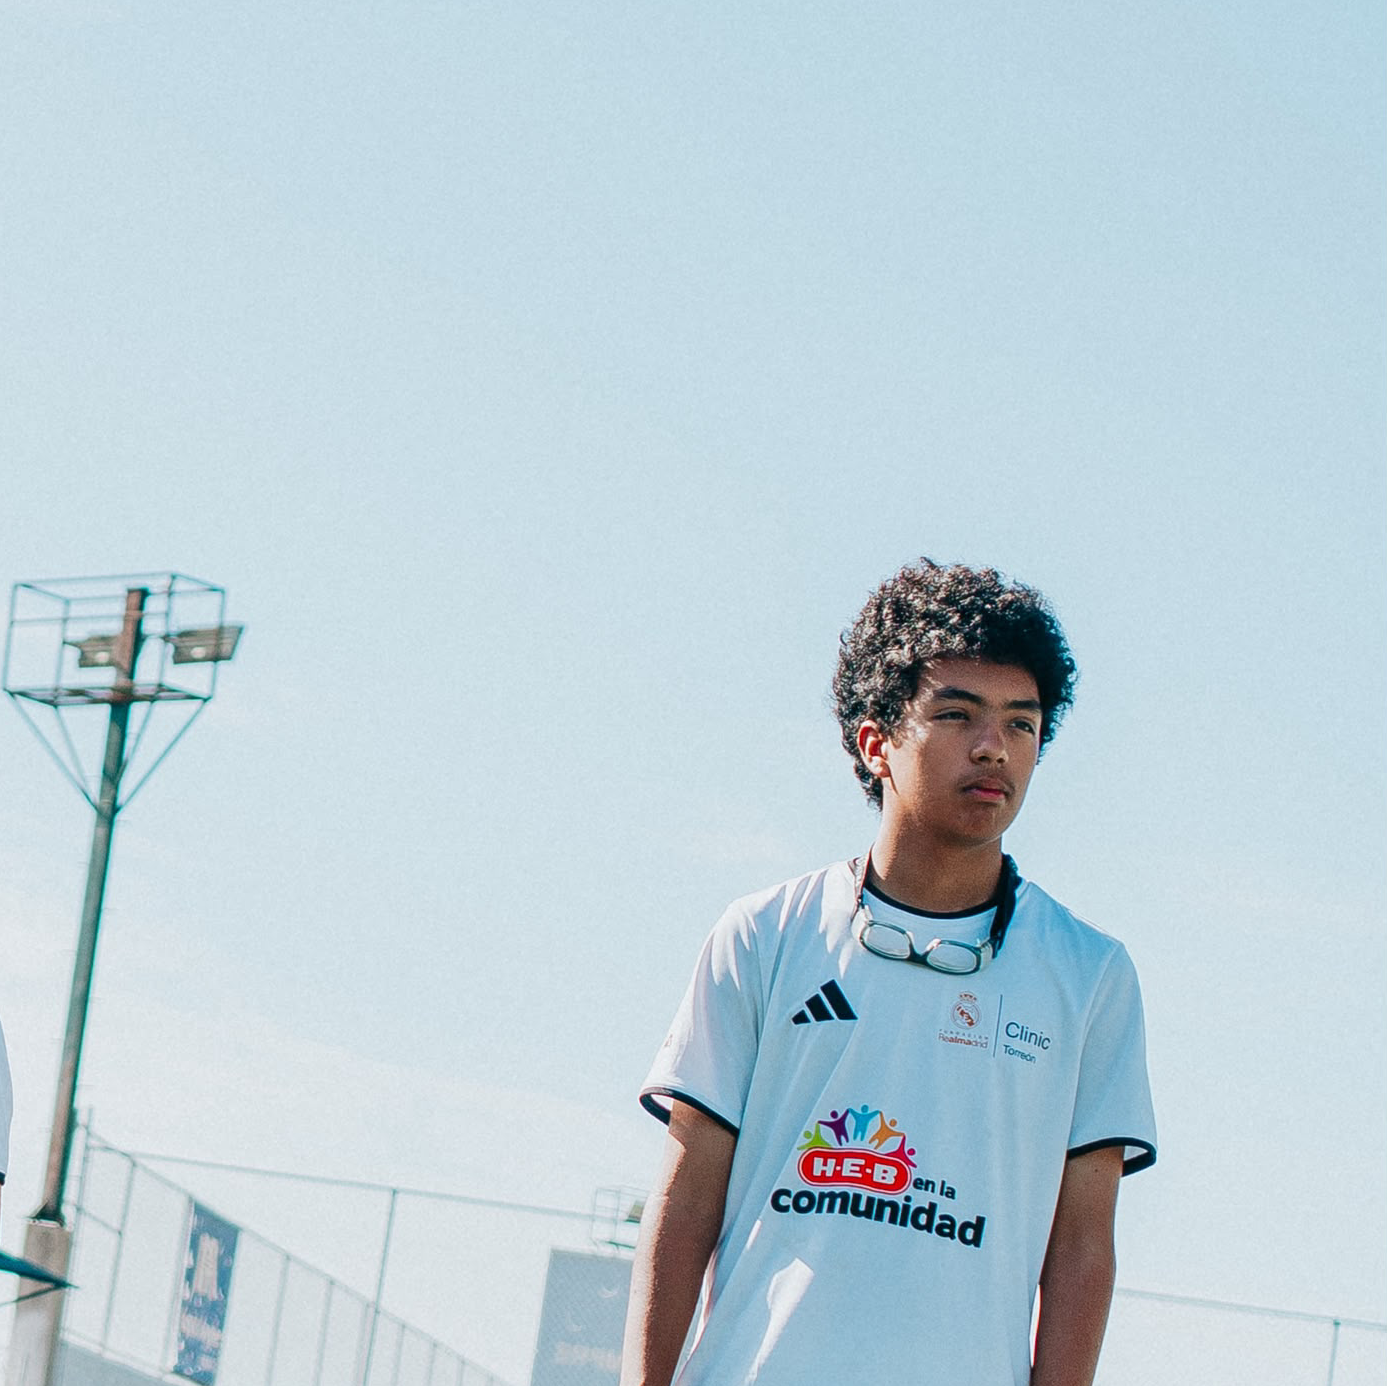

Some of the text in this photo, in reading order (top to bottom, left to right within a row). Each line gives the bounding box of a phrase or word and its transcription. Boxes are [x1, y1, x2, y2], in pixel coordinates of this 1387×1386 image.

[1005, 1021, 1051, 1050] Clinic
[1003, 1044, 1036, 1064] Torreón
[913, 1176, 935, 1193] en
[940, 1180, 956, 1200] la
[770, 1187, 987, 1249] comunidad
